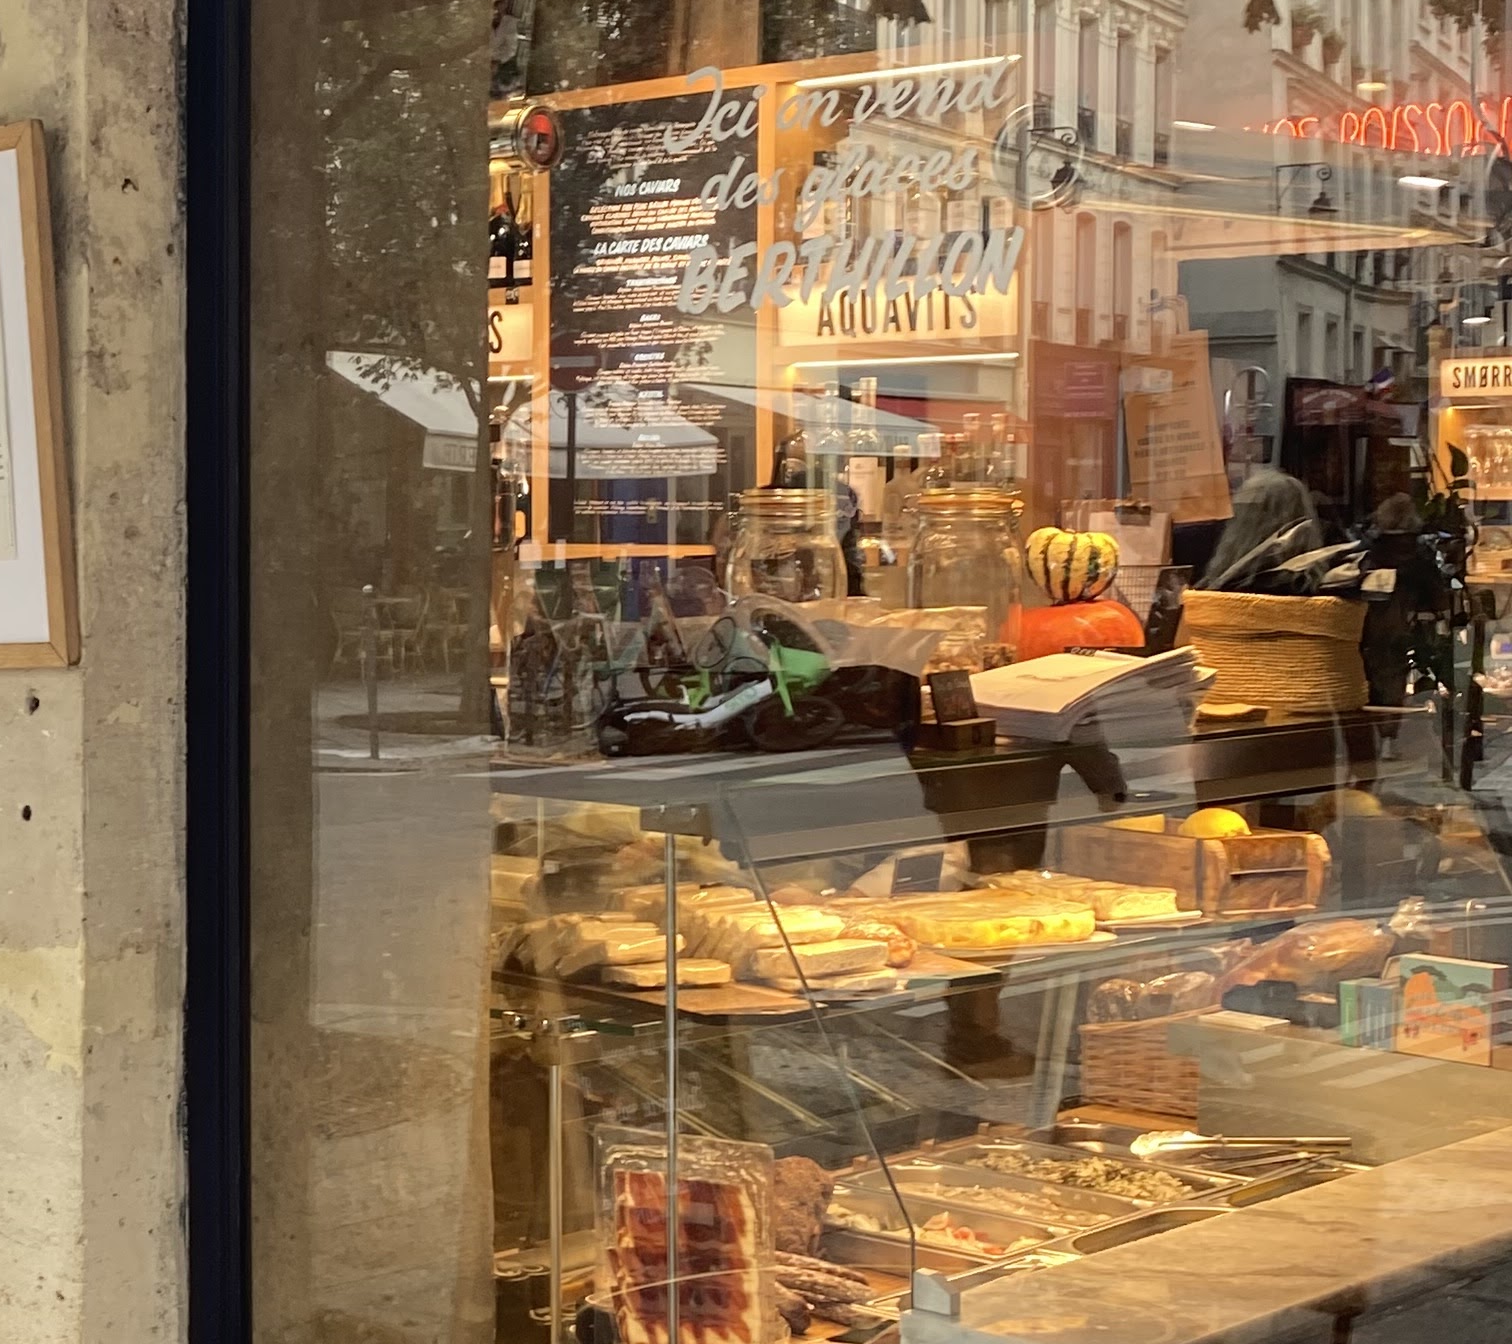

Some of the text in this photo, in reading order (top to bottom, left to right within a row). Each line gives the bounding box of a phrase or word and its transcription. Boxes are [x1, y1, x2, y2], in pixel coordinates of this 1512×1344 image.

[663, 66, 768, 153] Ici
[776, 88, 845, 131] on
[852, 59, 1017, 125] vend
[615, 178, 681, 197] NOS CAVIARS
[701, 155, 785, 211] des
[794, 143, 980, 233] glaces
[593, 234, 709, 255] LA CARTE DES CAVIARS
[676, 225, 1025, 315] BERTHILLON
[817, 285, 977, 337] AQUAVITS
